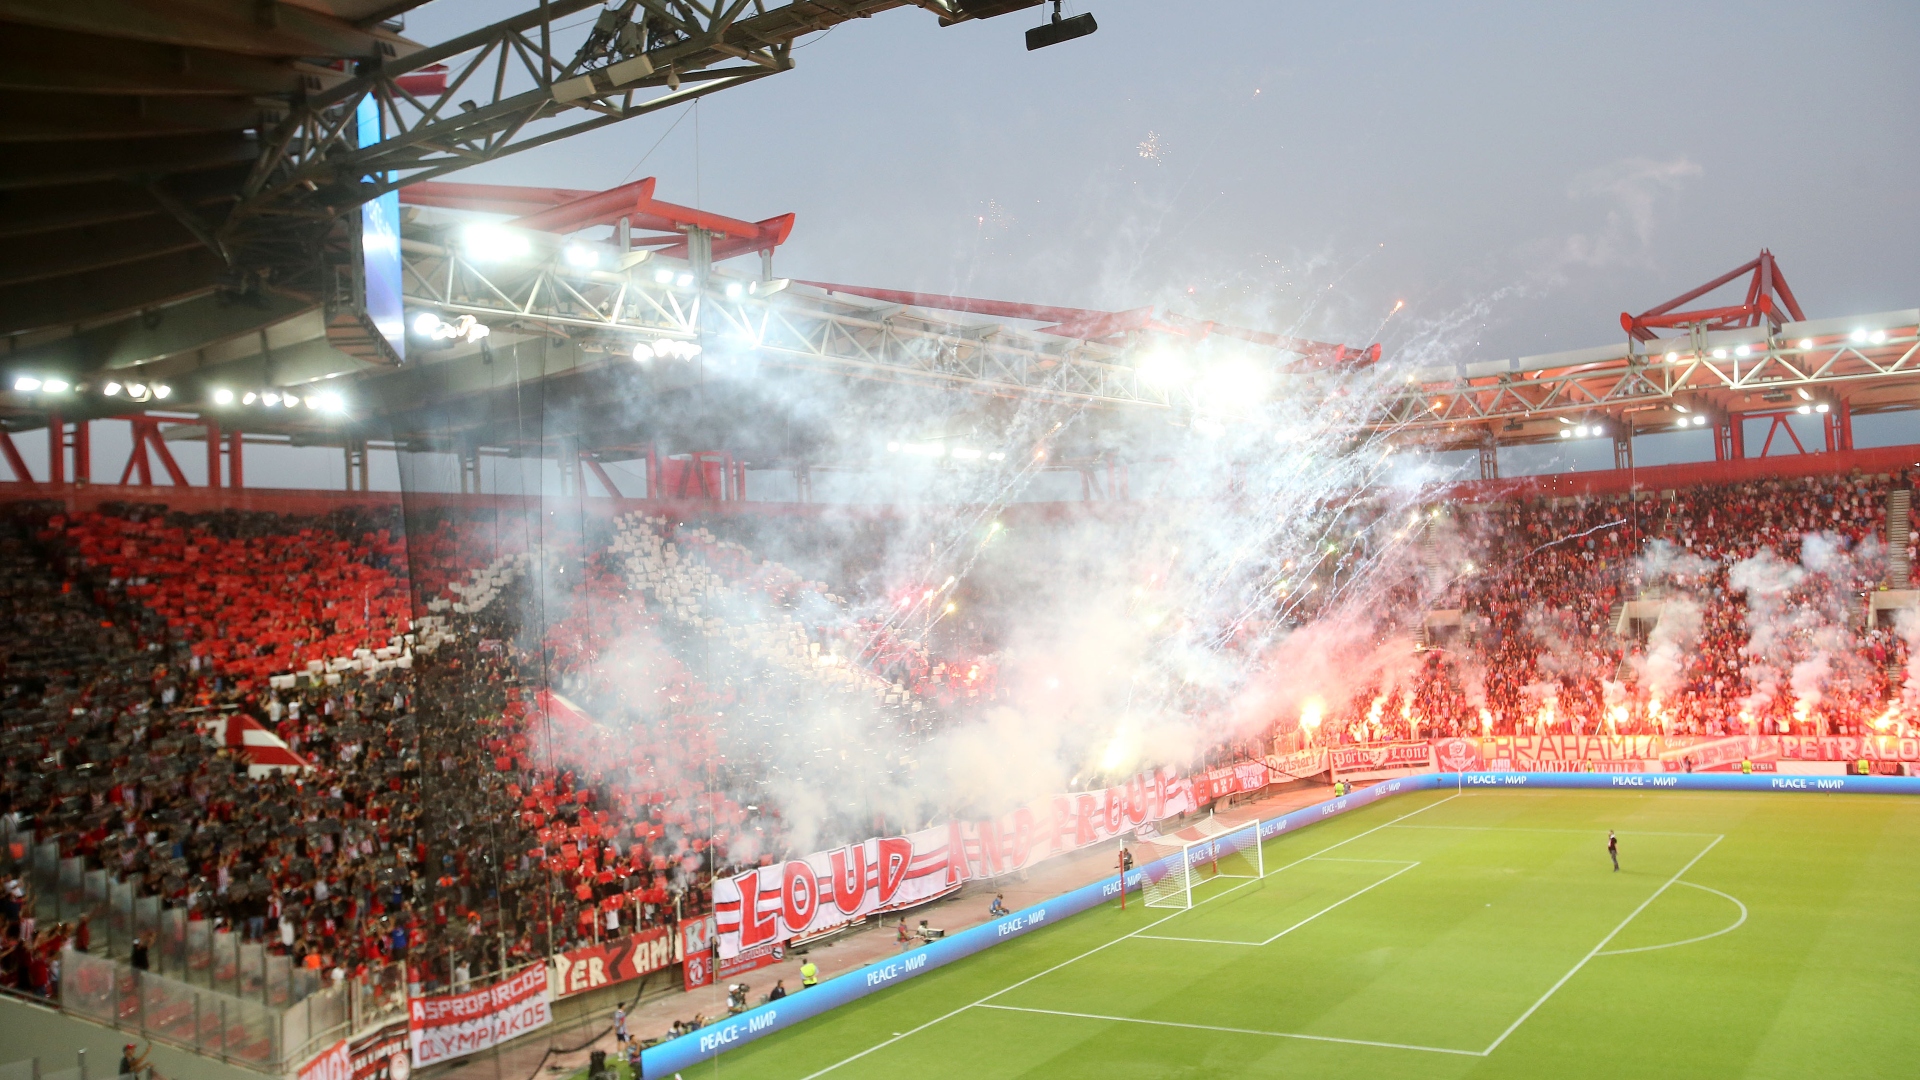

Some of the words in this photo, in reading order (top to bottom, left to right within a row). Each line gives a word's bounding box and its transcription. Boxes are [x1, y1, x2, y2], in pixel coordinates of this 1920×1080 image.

[1665, 739, 1687, 748] Gate
[1334, 752, 1369, 767] Porto
[1392, 747, 1427, 759] Leone
[1467, 775, 1496, 784] PEACE
[1612, 777, 1643, 786] PEACE
[1772, 778, 1806, 788] PEACE
[734, 836, 914, 951] LOUD
[946, 806, 1036, 885] AND
[1051, 768, 1168, 848] PROUD
[998, 917, 1023, 937] PEACE
[866, 964, 898, 987] PEACE
[419, 1002, 544, 1061] OLYMPIAKOS
[700, 1025, 739, 1053] PEACE
